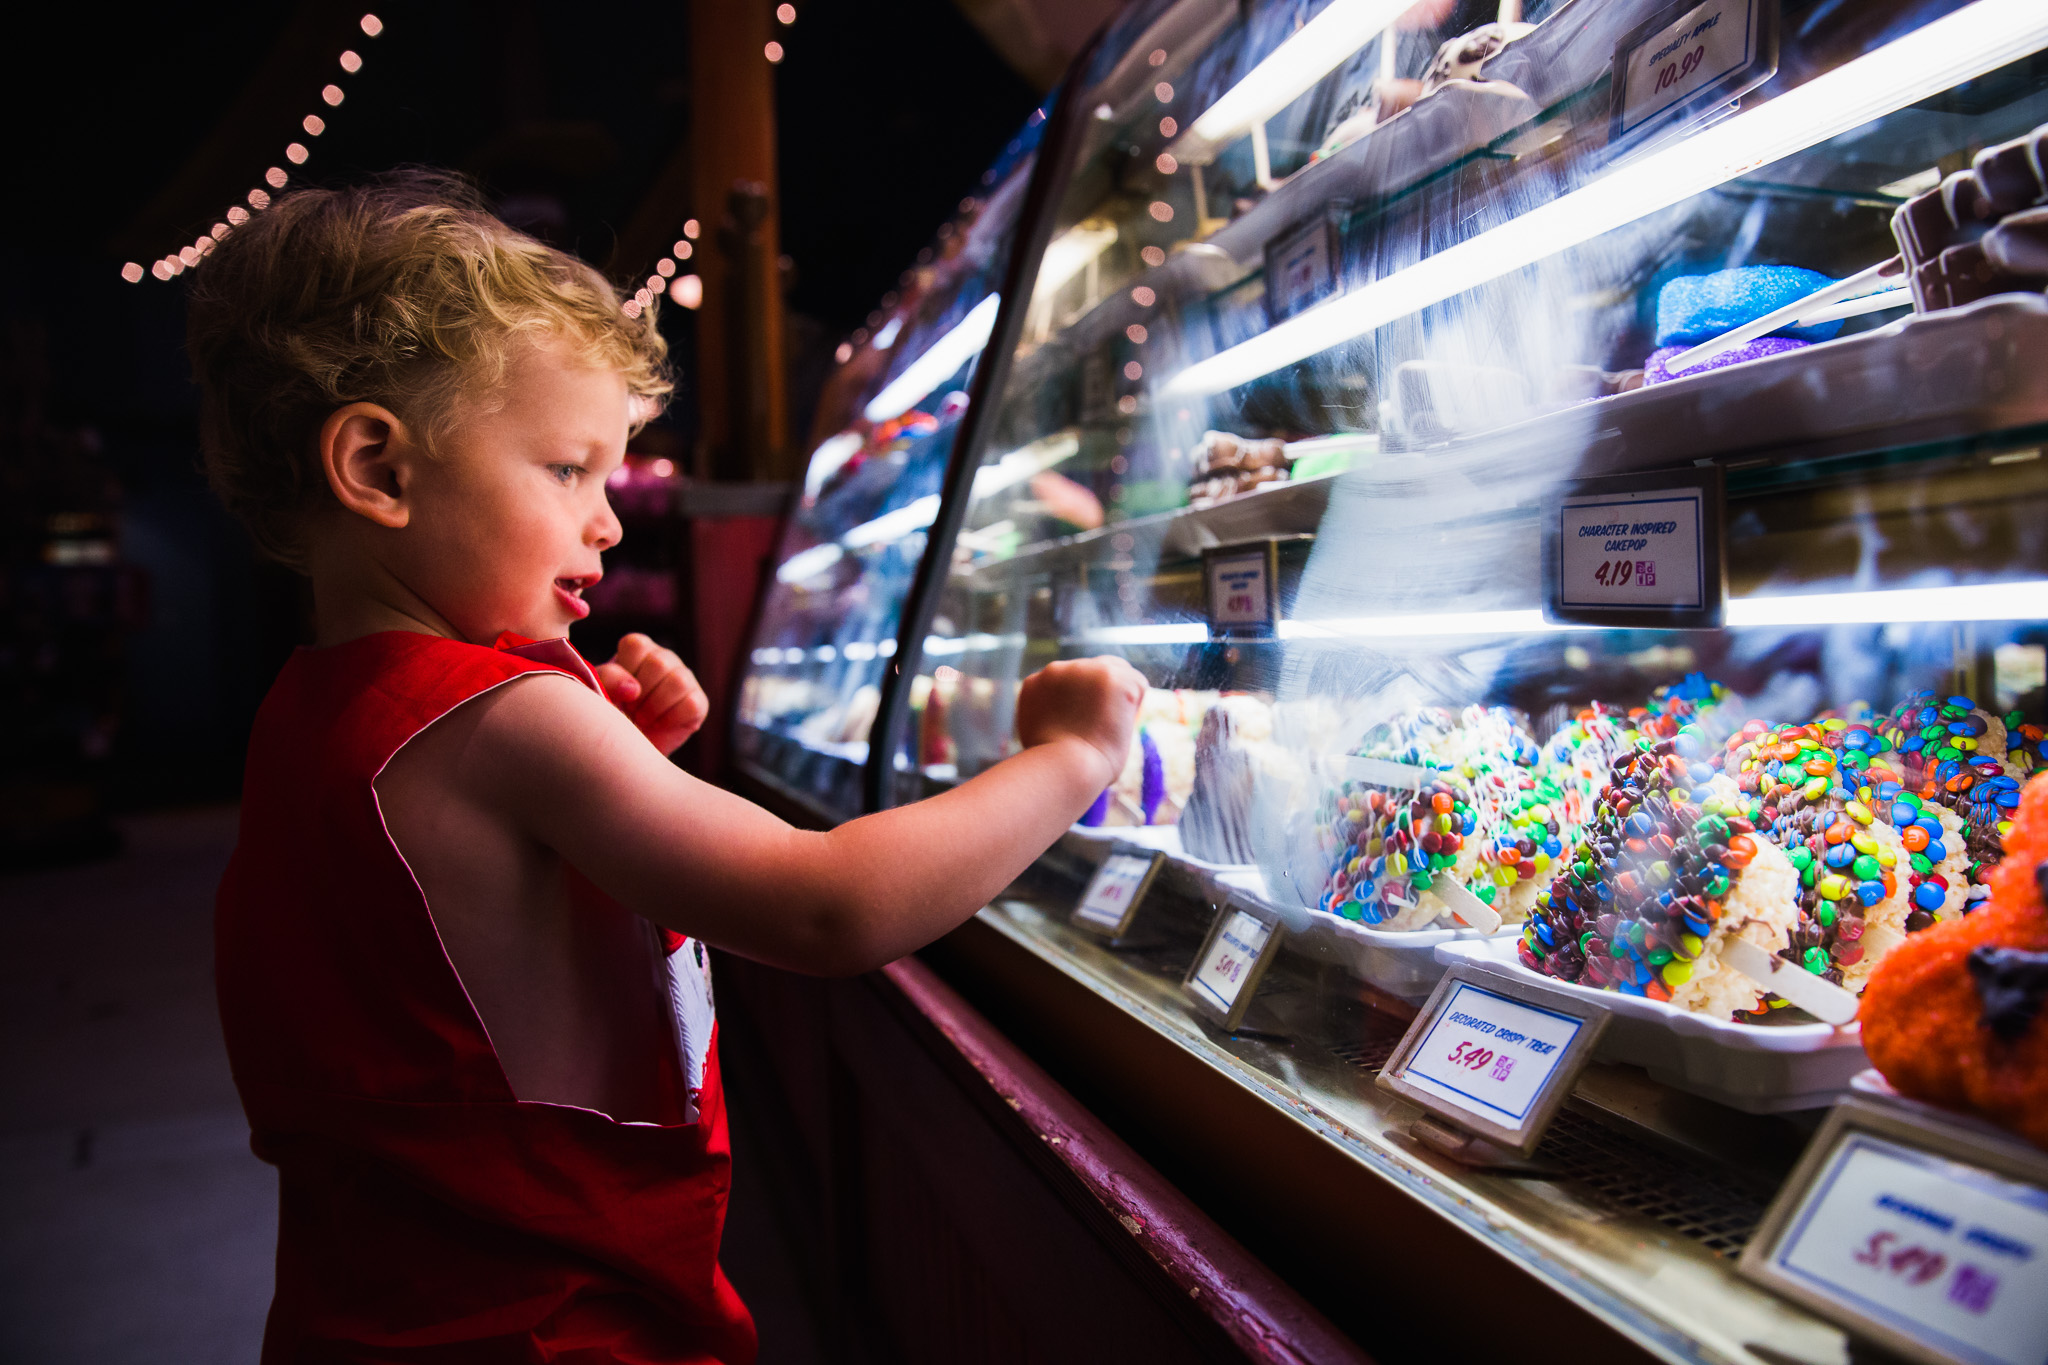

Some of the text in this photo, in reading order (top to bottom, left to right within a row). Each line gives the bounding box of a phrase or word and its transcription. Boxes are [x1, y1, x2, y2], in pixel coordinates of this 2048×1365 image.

[1649, 12, 1722, 66] SPECIALTY APPLE
[1655, 45, 1704, 94] 10.99
[1578, 521, 1677, 537] CHARACTER INSPIRED
[1604, 539, 1647, 551] CAKEPOP
[1594, 560, 1633, 587] 4.19
[1448, 1011, 1558, 1055] DECORATED CRISPY TREAT
[1448, 1041, 1494, 1071] 5.49
